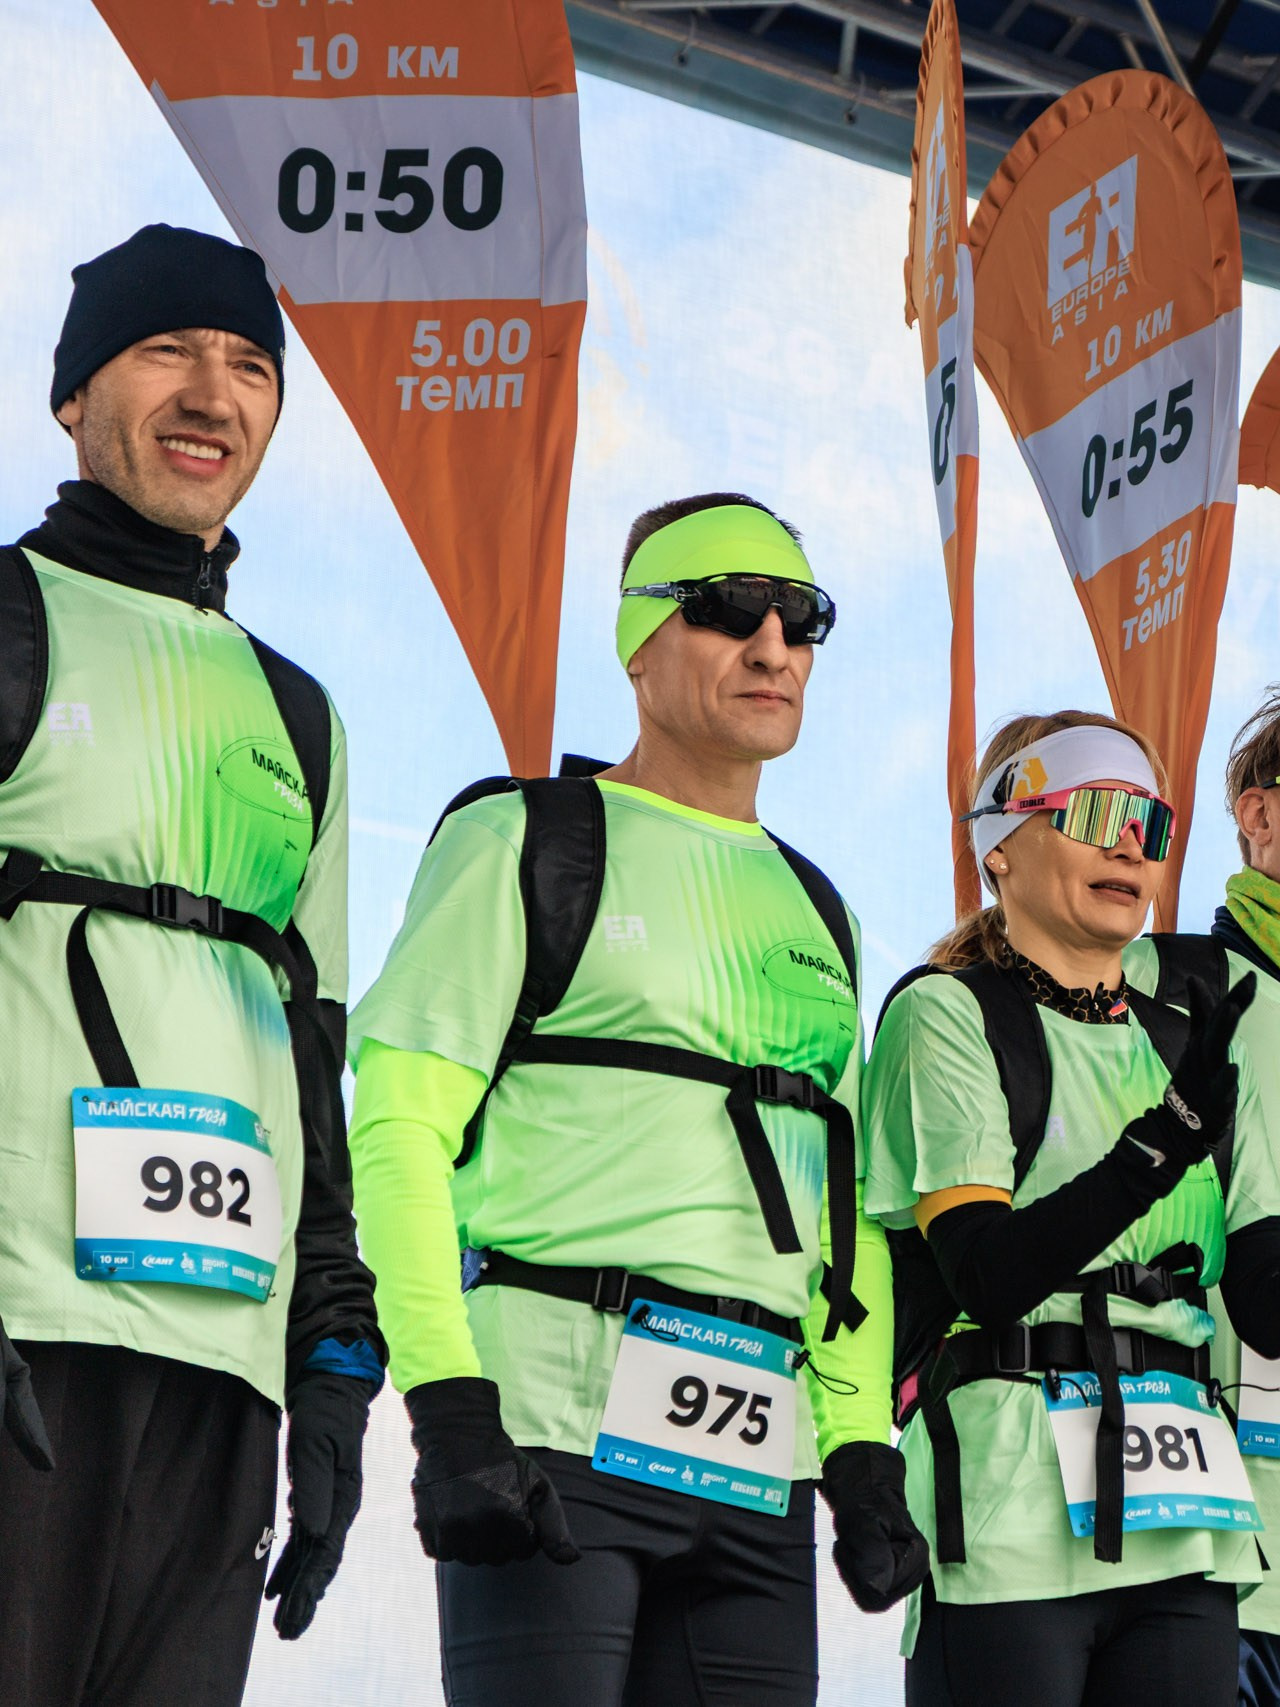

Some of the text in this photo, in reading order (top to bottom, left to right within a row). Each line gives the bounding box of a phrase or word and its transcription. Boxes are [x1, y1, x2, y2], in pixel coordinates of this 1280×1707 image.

[293, 33, 359, 81] 10
[278, 146, 504, 234] 0:50
[1051, 256, 1131, 323] EUROPE
[1051, 279, 1129, 346] ASIA
[411, 318, 532, 367] 5.00
[1085, 324, 1122, 383] 10
[395, 373, 526, 411] темп
[1081, 378, 1195, 519] 0:55
[1134, 529, 1192, 606] 5.30
[1121, 578, 1186, 651] темп
[251, 748, 311, 799] МАЙСКА
[87, 1098, 228, 1127] МАЙСКАЯ ГРОЗА
[140, 1155, 252, 1228] 982
[100, 1255, 111, 1264] 10
[665, 1375, 773, 1446] 975
[1254, 1434, 1263, 1442] 10
[614, 1452, 625, 1462] 10
[1123, 1425, 1209, 1474] 981
